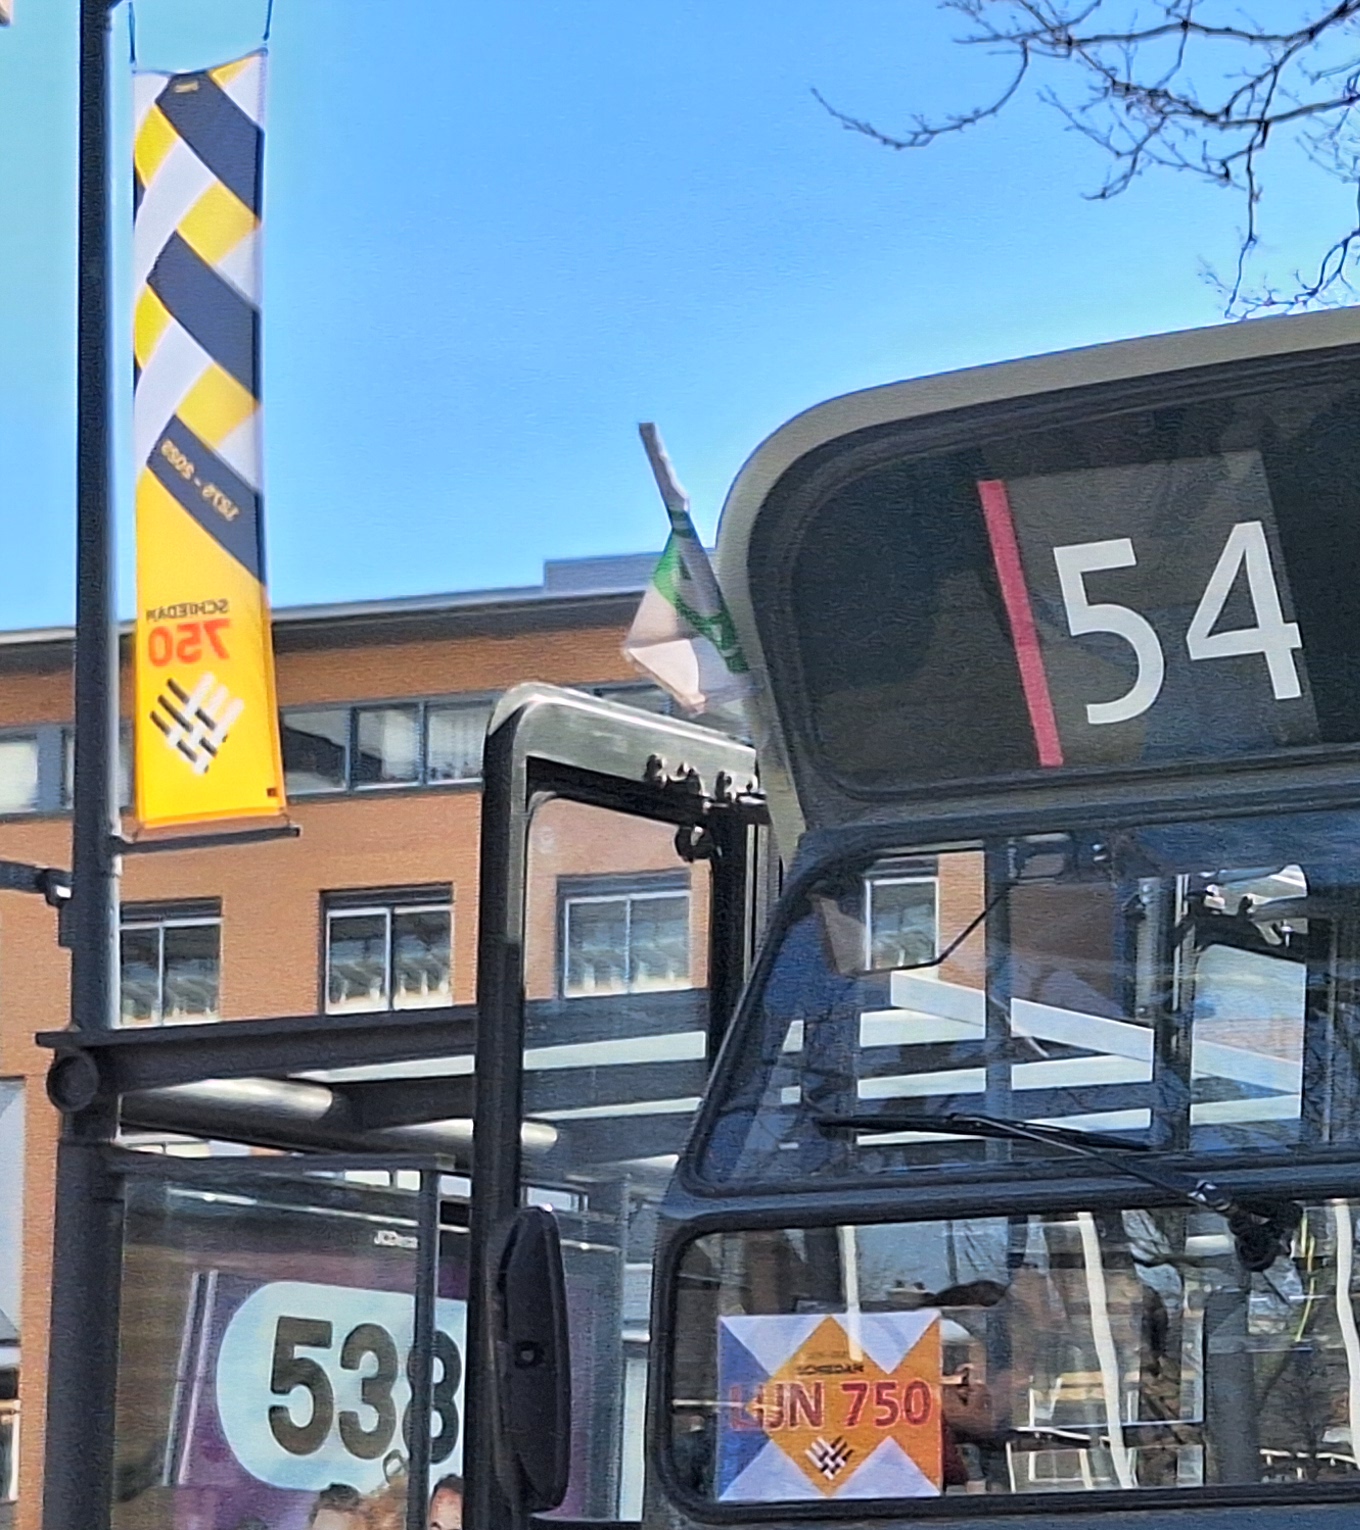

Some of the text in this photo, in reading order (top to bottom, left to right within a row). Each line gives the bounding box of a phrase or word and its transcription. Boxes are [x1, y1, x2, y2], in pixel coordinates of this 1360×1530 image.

[1053, 521, 1302, 725] 54
[268, 1315, 462, 1466] 538
[841, 1380, 932, 1429] 750
